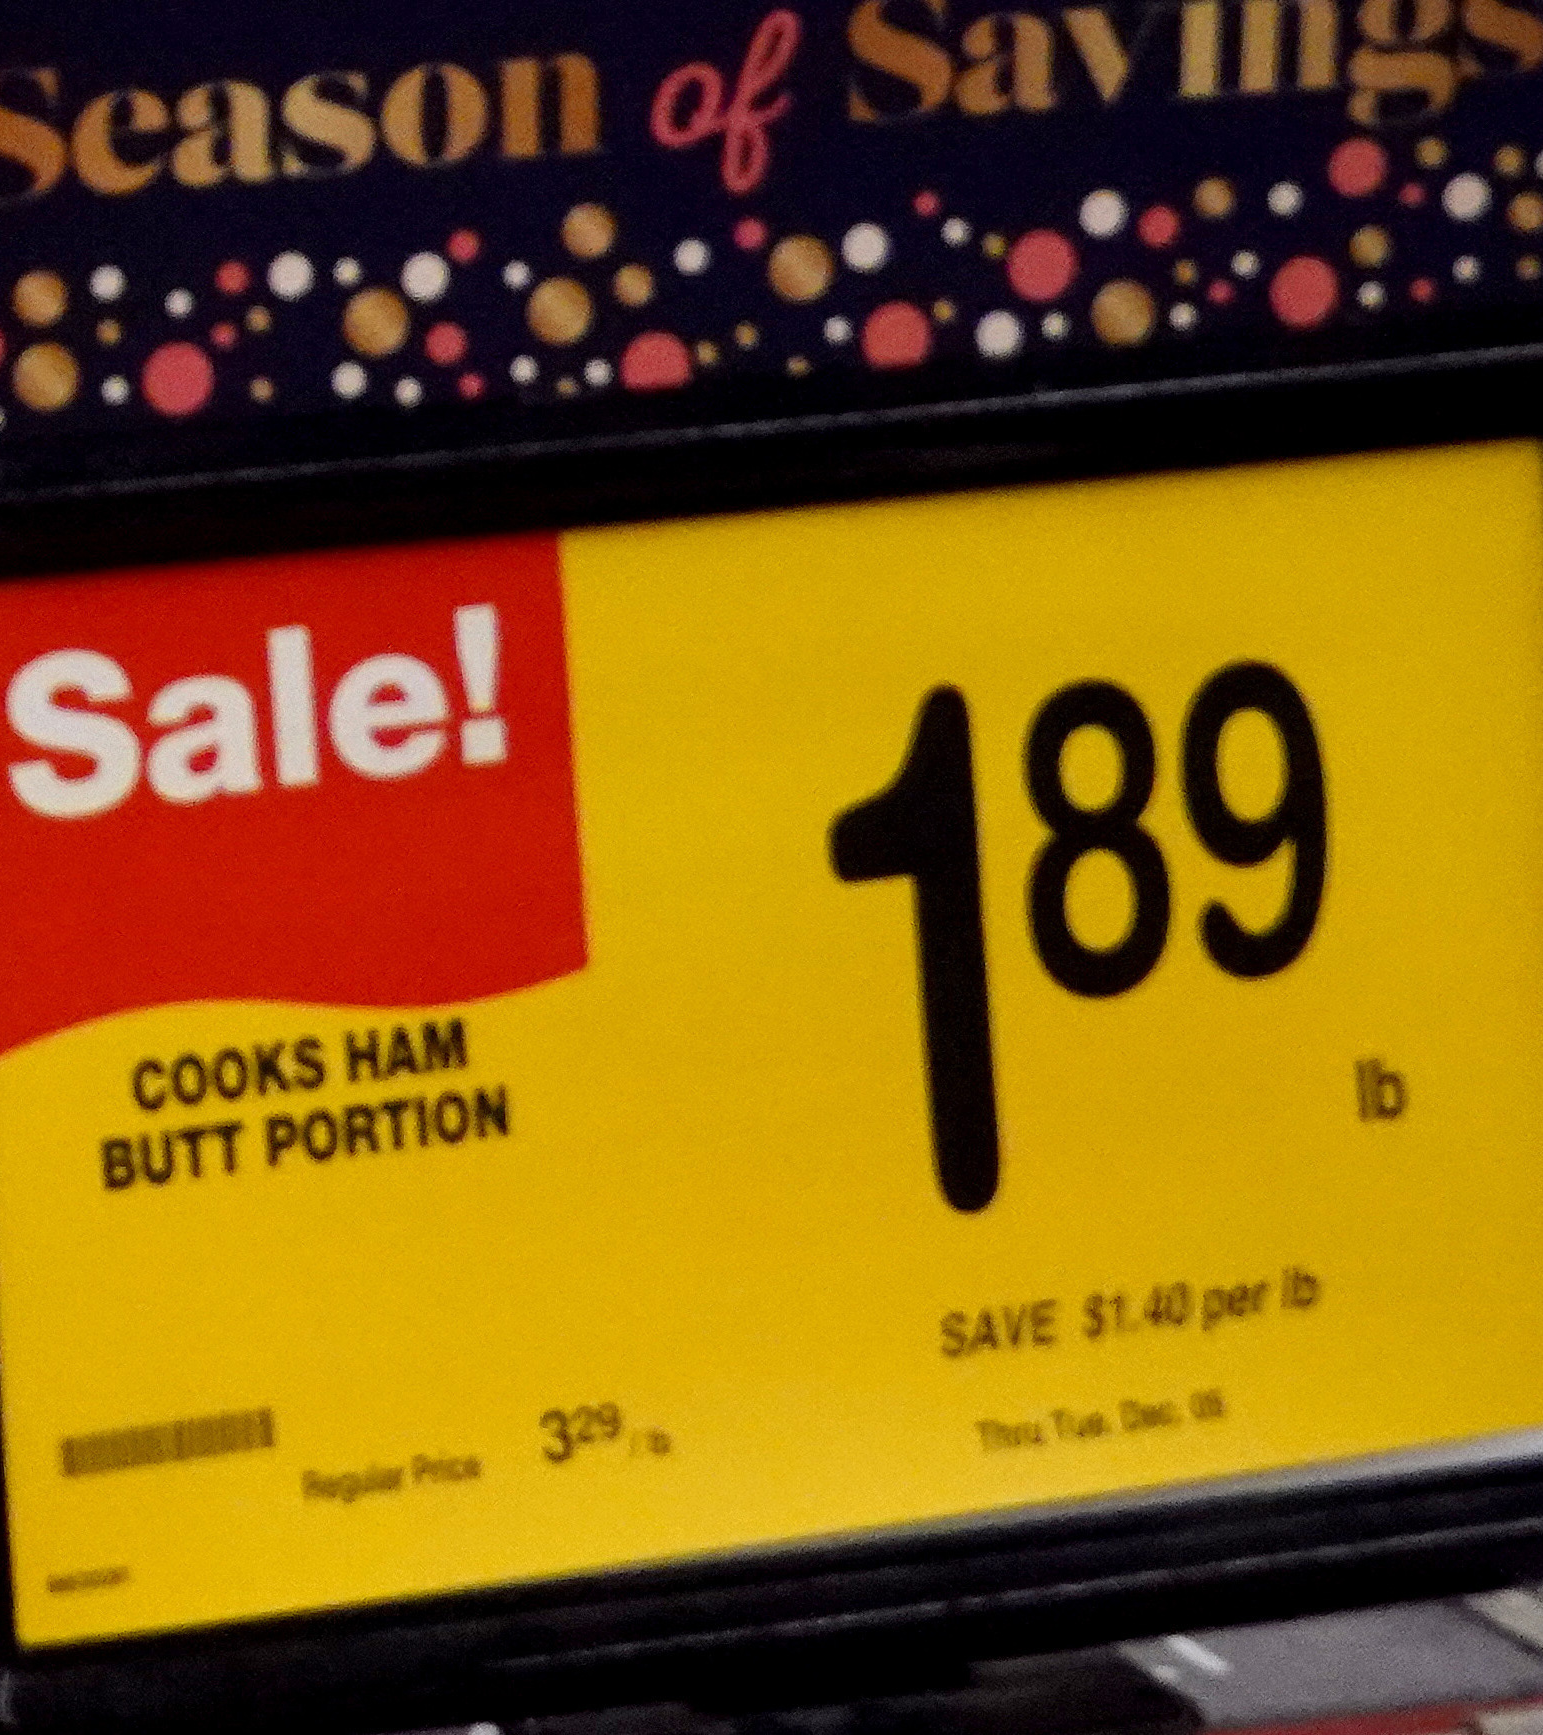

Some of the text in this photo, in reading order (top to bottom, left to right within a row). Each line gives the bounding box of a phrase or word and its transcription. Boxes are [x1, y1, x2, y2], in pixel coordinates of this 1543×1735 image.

[651, 8, 798, 198] of
[6, 600, 509, 821] Sale!
[826, 657, 1331, 1219] 189
[131, 1019, 469, 1111] COOKS HAM
[1353, 1058, 1409, 1124] lb
[101, 1084, 511, 1192] BUTT PORTION
[939, 1265, 1325, 1360] SAVE $1.40 per lb
[299, 1400, 624, 1504] Regular Price 329
